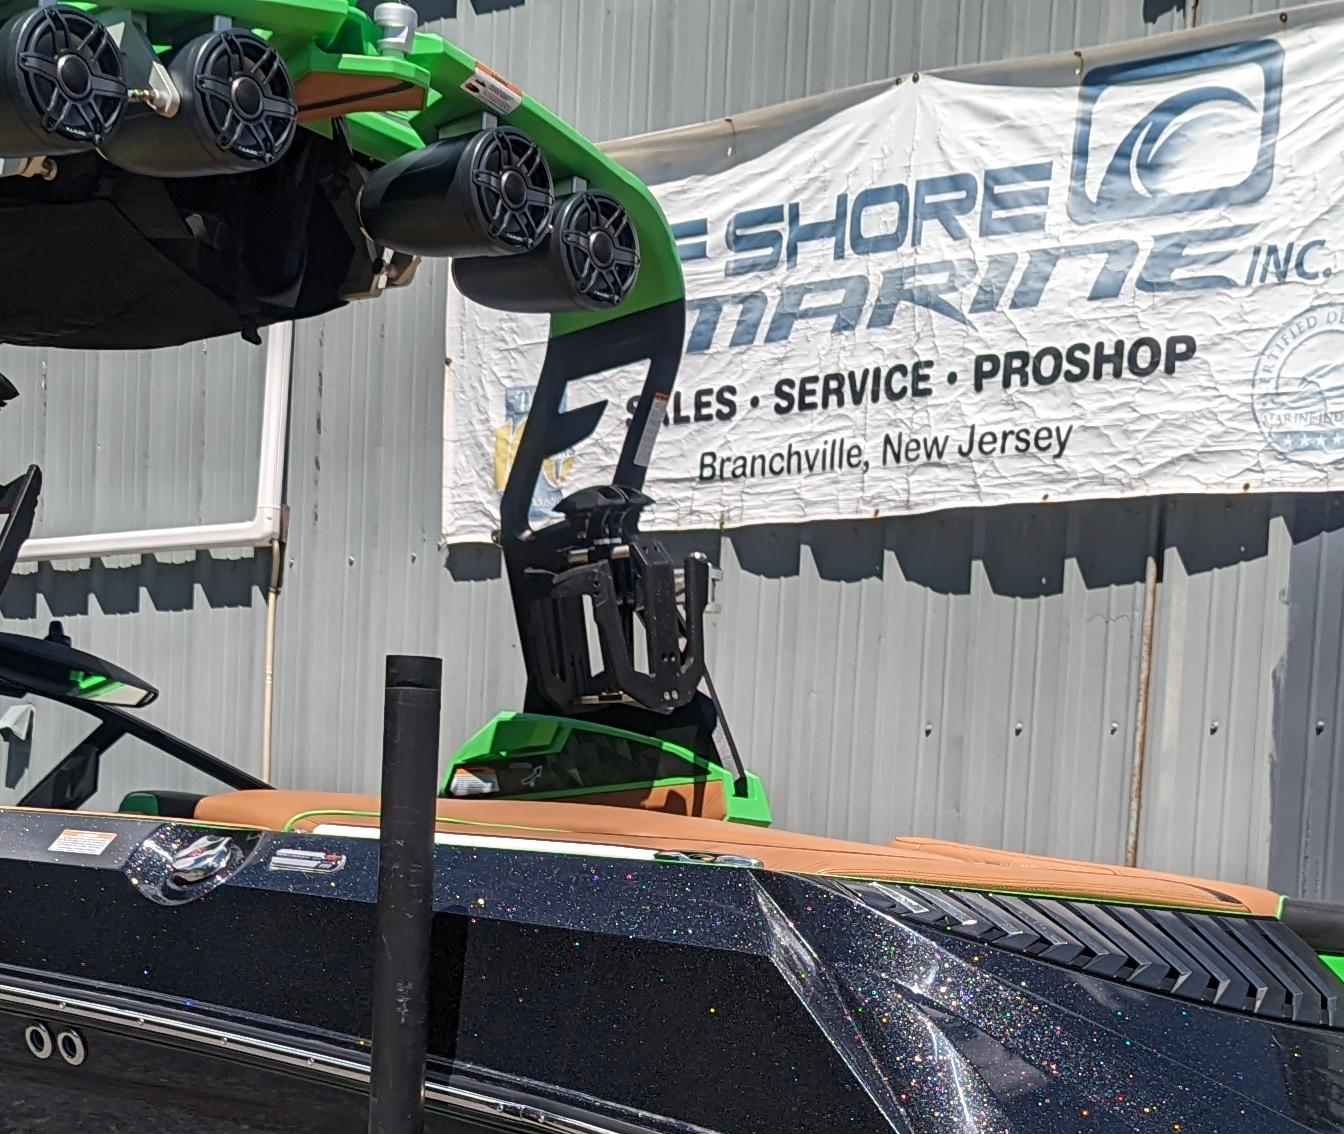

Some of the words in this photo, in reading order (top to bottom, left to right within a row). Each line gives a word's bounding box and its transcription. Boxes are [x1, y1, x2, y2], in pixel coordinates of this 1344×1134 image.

[724, 161, 1053, 277] SHORE
[685, 223, 1260, 354] MARINE
[1244, 239, 1333, 287] INC.
[626, 384, 737, 430] SLES
[774, 359, 935, 416] SERVICE
[973, 334, 1197, 393] PROSHOP
[698, 437, 870, 481] Branchville,
[882, 429, 950, 467] New
[958, 423, 1074, 460] Jersey
